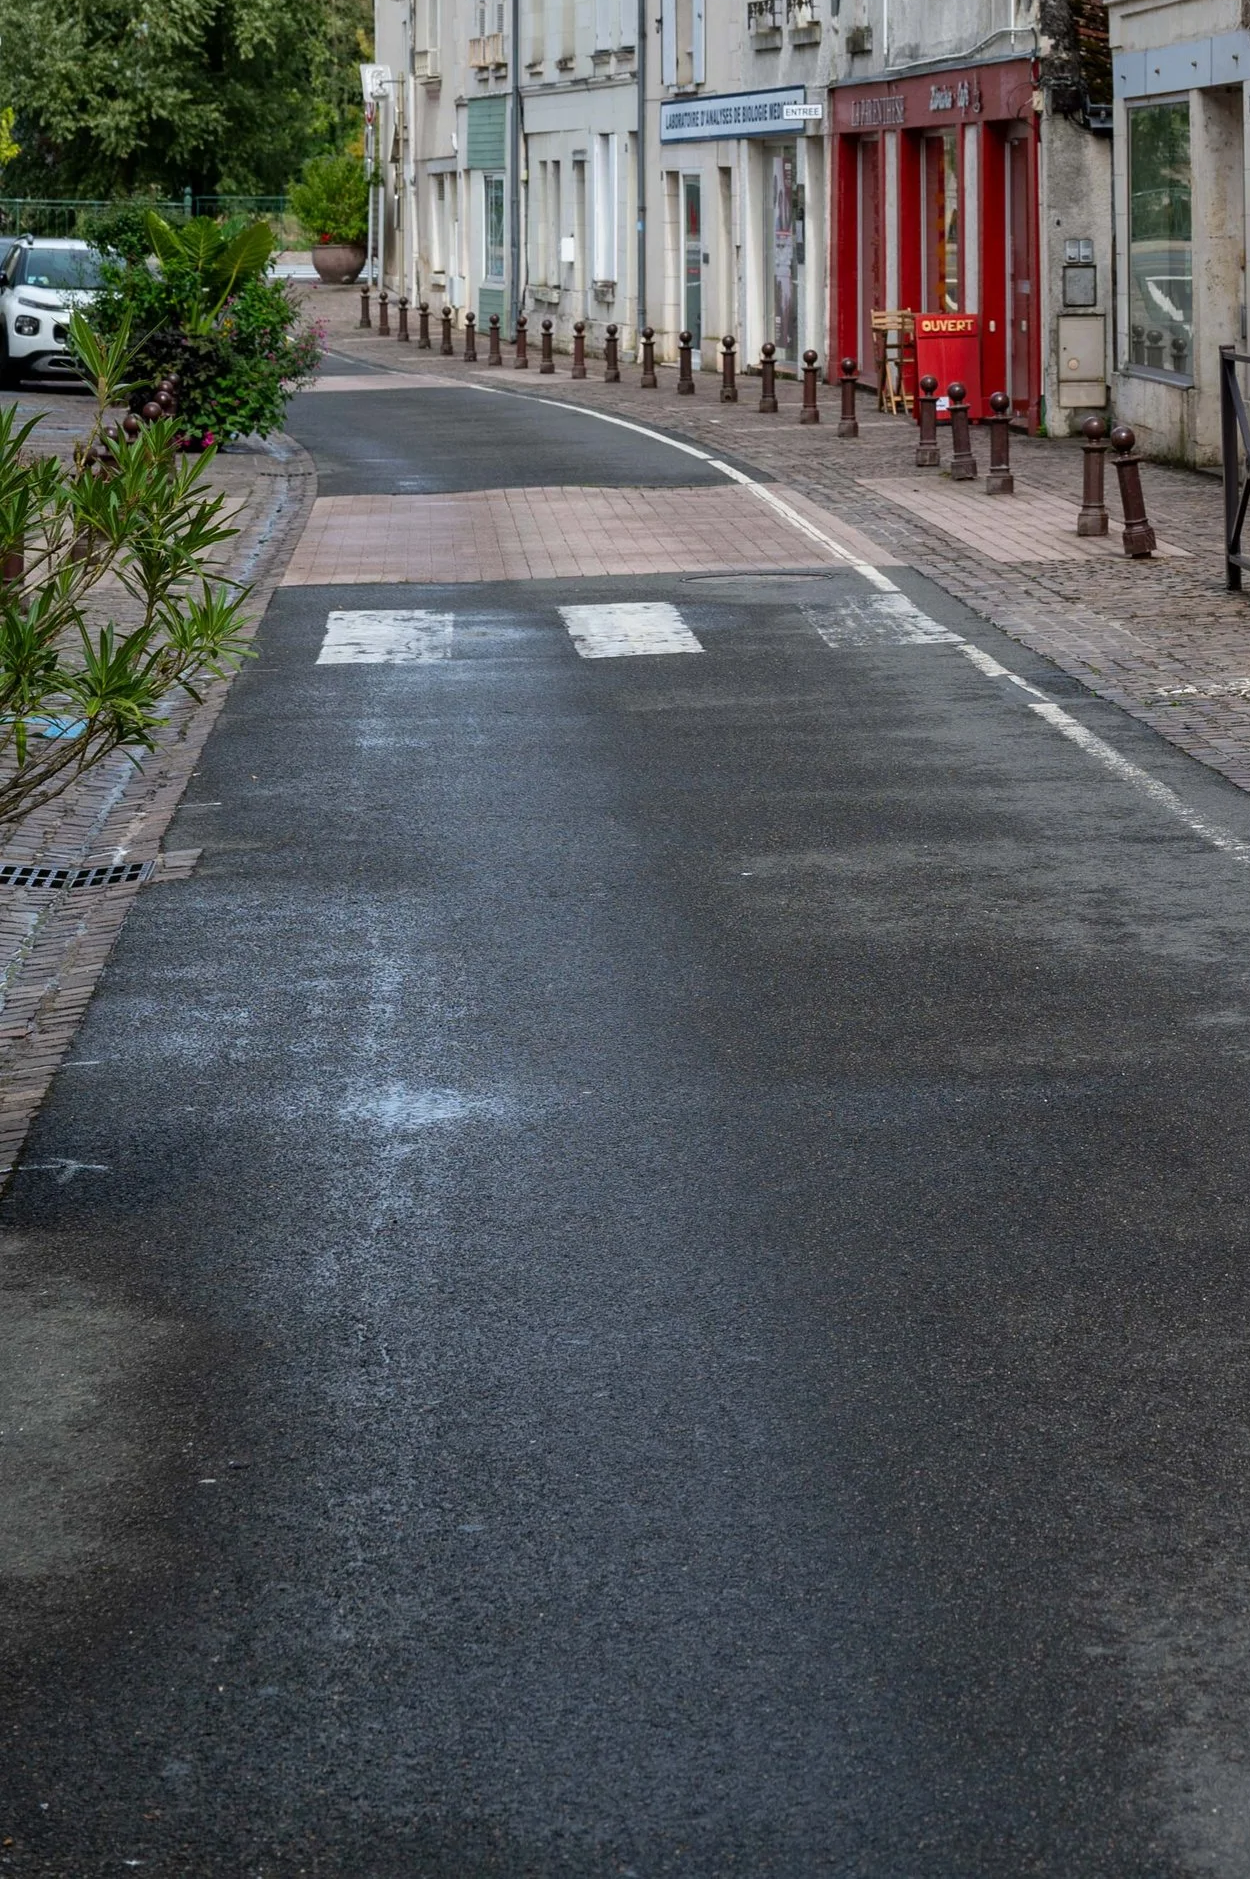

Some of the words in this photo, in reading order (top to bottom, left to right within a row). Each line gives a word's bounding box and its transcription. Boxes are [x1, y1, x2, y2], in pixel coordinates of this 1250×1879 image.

[665, 110, 699, 130] LABORATOIRE
[700, 107, 732, 127] D'ANALYSES
[733, 106, 741, 124] DE
[742, 103, 768, 123] BIOLOGIE
[785, 108, 819, 117] ENTREE
[921, 319, 974, 332] OUVERT
